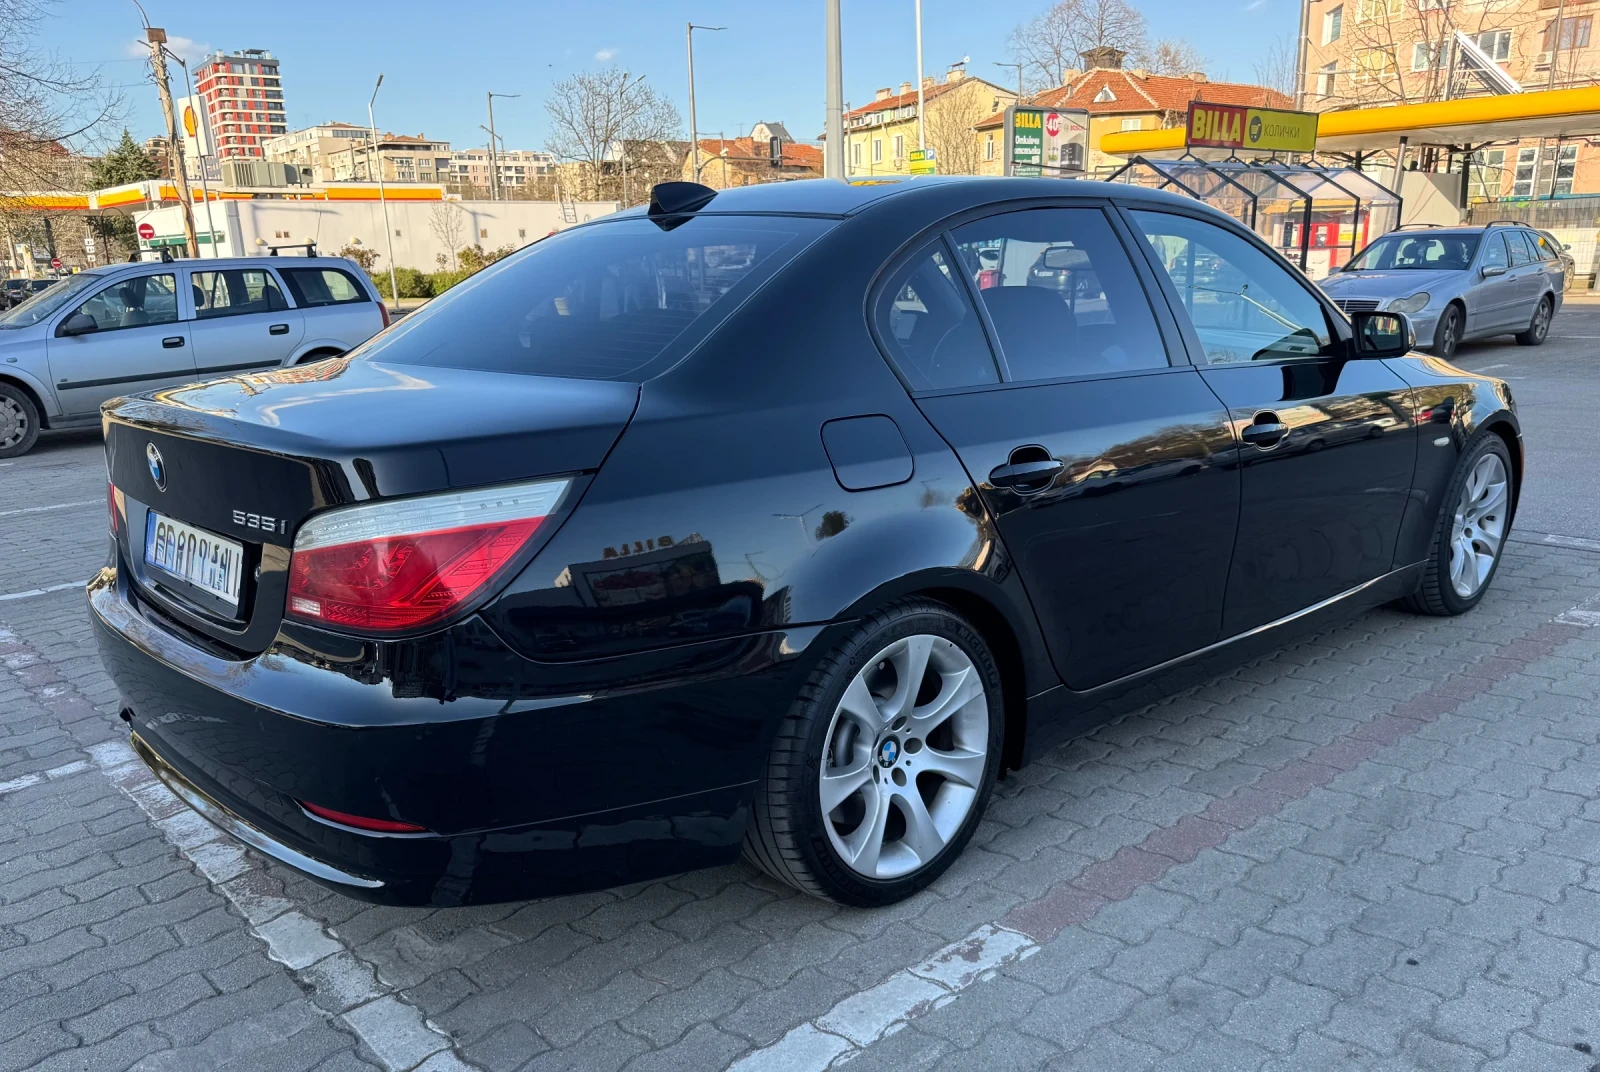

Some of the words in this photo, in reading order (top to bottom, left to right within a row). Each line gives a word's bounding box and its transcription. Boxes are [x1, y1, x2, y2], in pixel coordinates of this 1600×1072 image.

[1014, 112, 1041, 129] BILLA
[1192, 109, 1240, 142] BILLA
[1263, 124, 1300, 139] КОЛИЧКИ
[958, 626, 999, 689] MICHELIN
